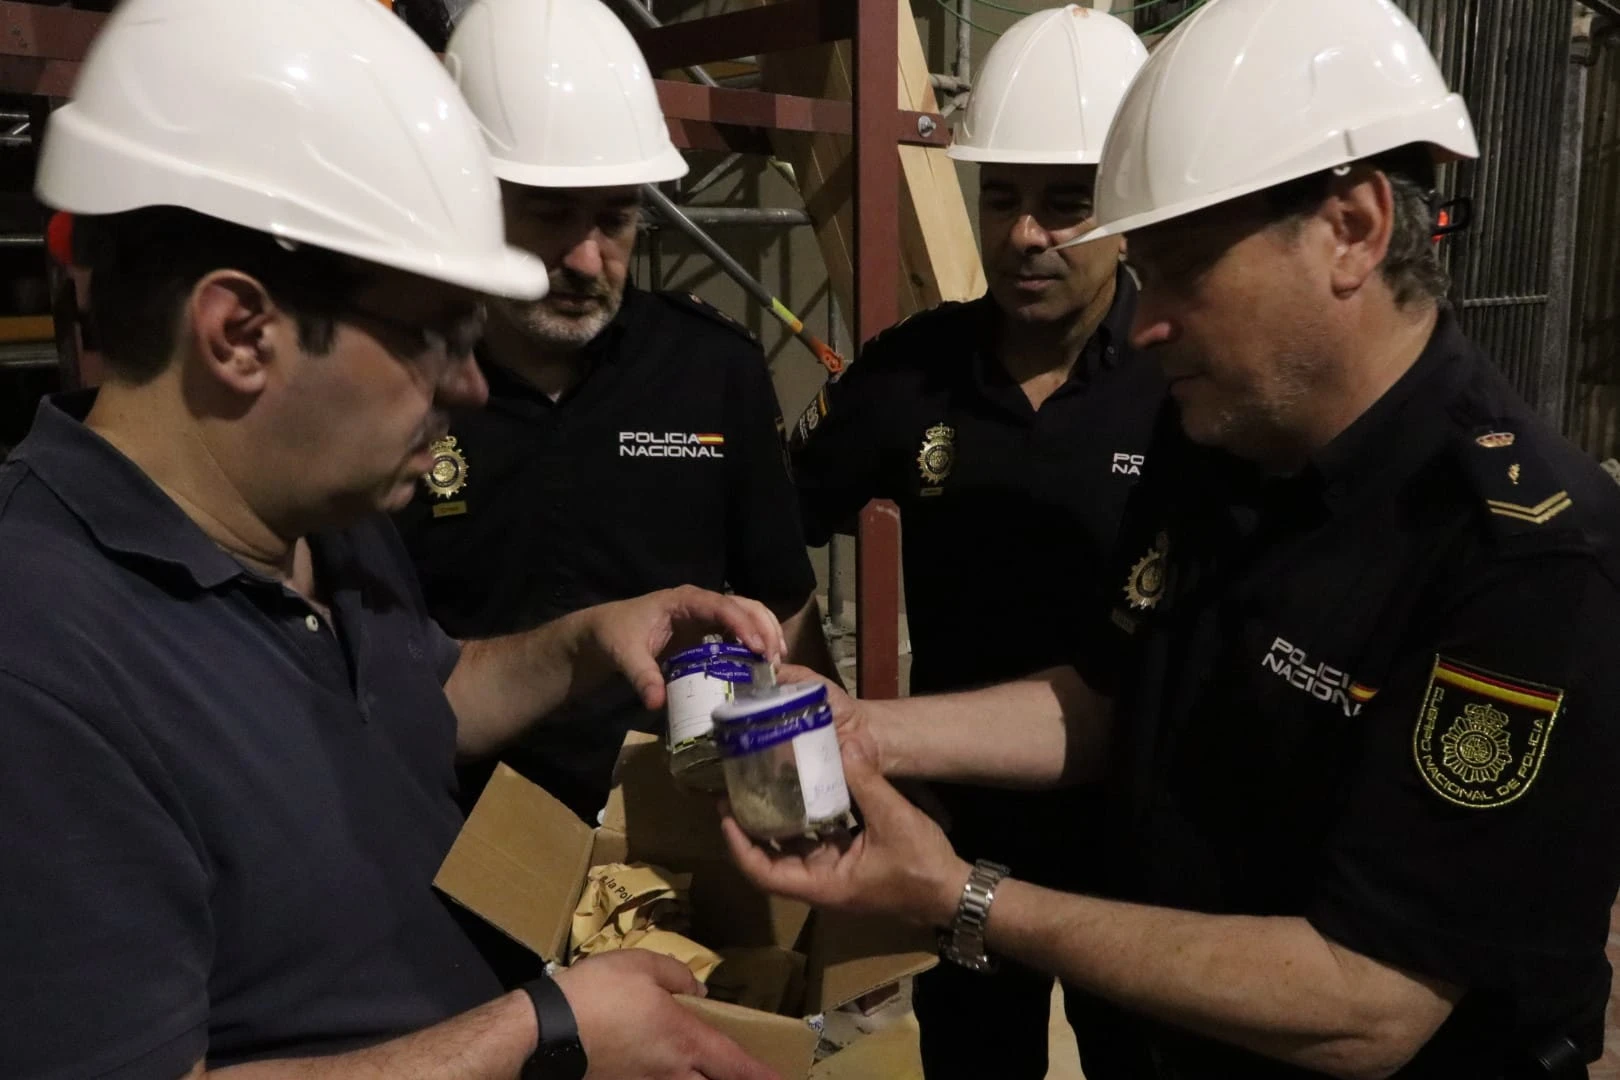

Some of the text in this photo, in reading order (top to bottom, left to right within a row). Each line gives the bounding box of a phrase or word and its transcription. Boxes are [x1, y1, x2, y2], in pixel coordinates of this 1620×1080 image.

[619, 431, 700, 444] POLICIA
[619, 445, 724, 458] NACIONAL
[1261, 652, 1362, 718] NACION
[1271, 636, 1351, 689] POLICI
[1422, 754, 1494, 801] NACIONAL
[1496, 778, 1521, 797] DE
[1517, 718, 1546, 779] POLICIA
